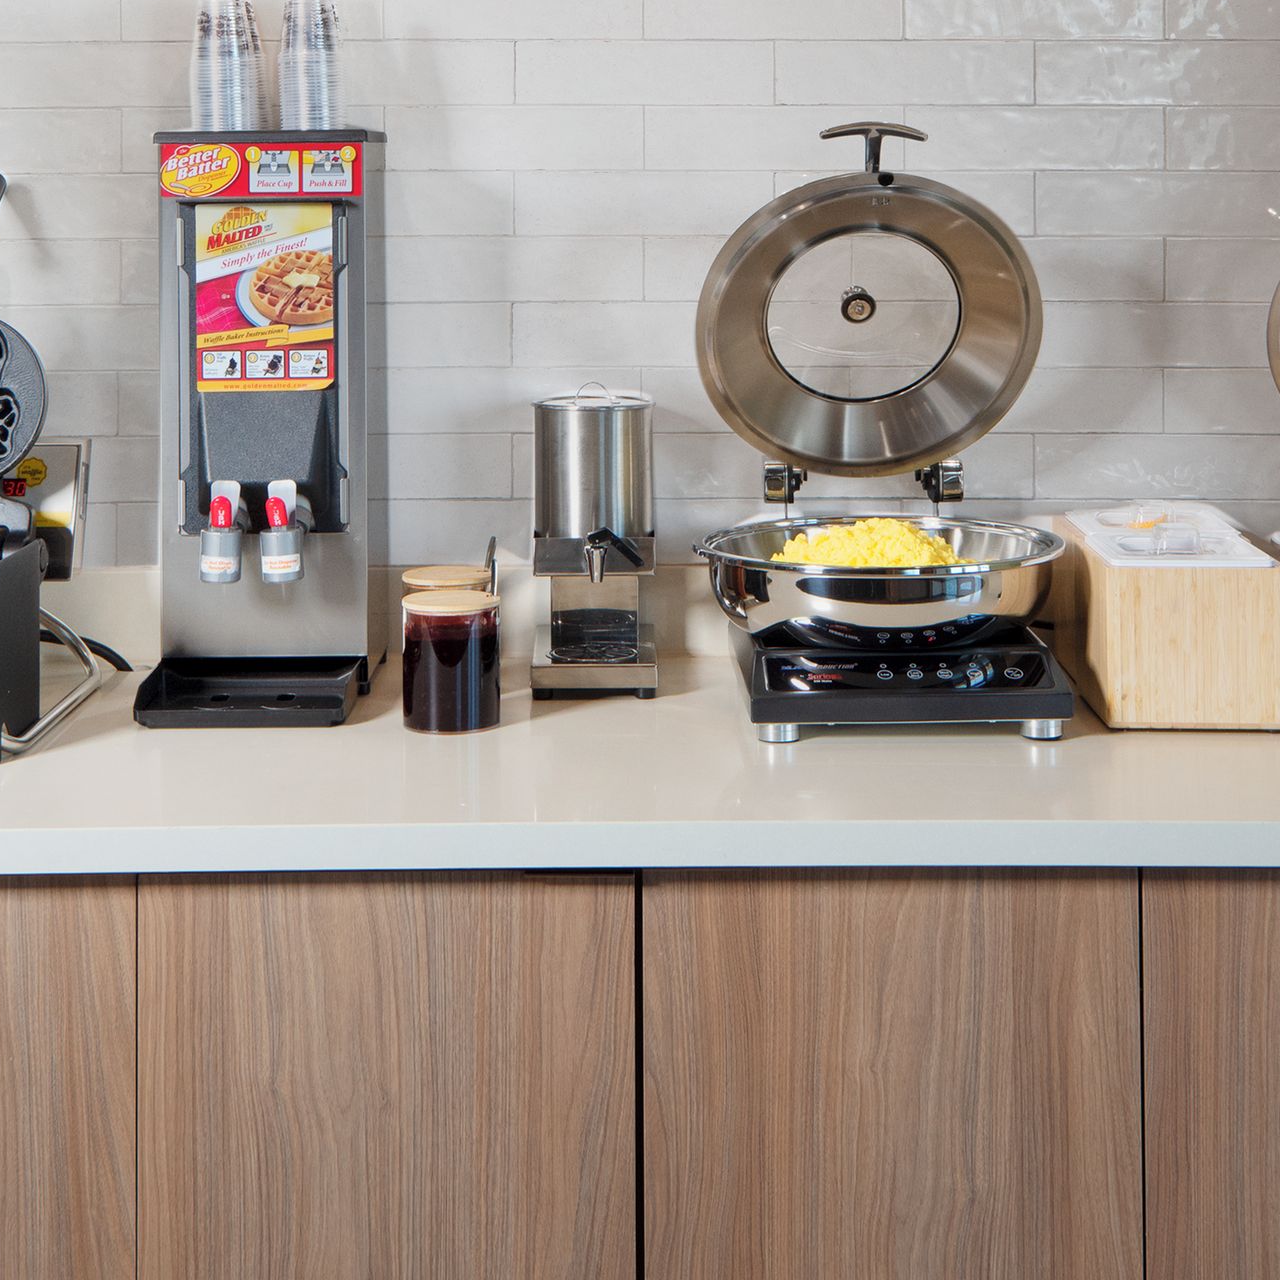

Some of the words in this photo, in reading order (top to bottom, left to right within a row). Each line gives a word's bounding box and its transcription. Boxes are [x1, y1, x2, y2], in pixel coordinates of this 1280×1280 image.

[166, 147, 222, 172] Better
[249, 147, 256, 160] 1
[343, 147, 352, 159] 2
[176, 157, 230, 181] Batter
[277, 180, 293, 189] Cup
[211, 210, 267, 235] GOLDEN
[206, 225, 263, 251] MALTED
[221, 253, 256, 269] Simply
[257, 249, 273, 259] the
[275, 237, 308, 254] Finest!
[203, 335, 225, 344] Waffle
[226, 333, 245, 341] Baker
[246, 328, 284, 338] Instructions
[223, 382, 308, 390] www.goldenmalted.com
